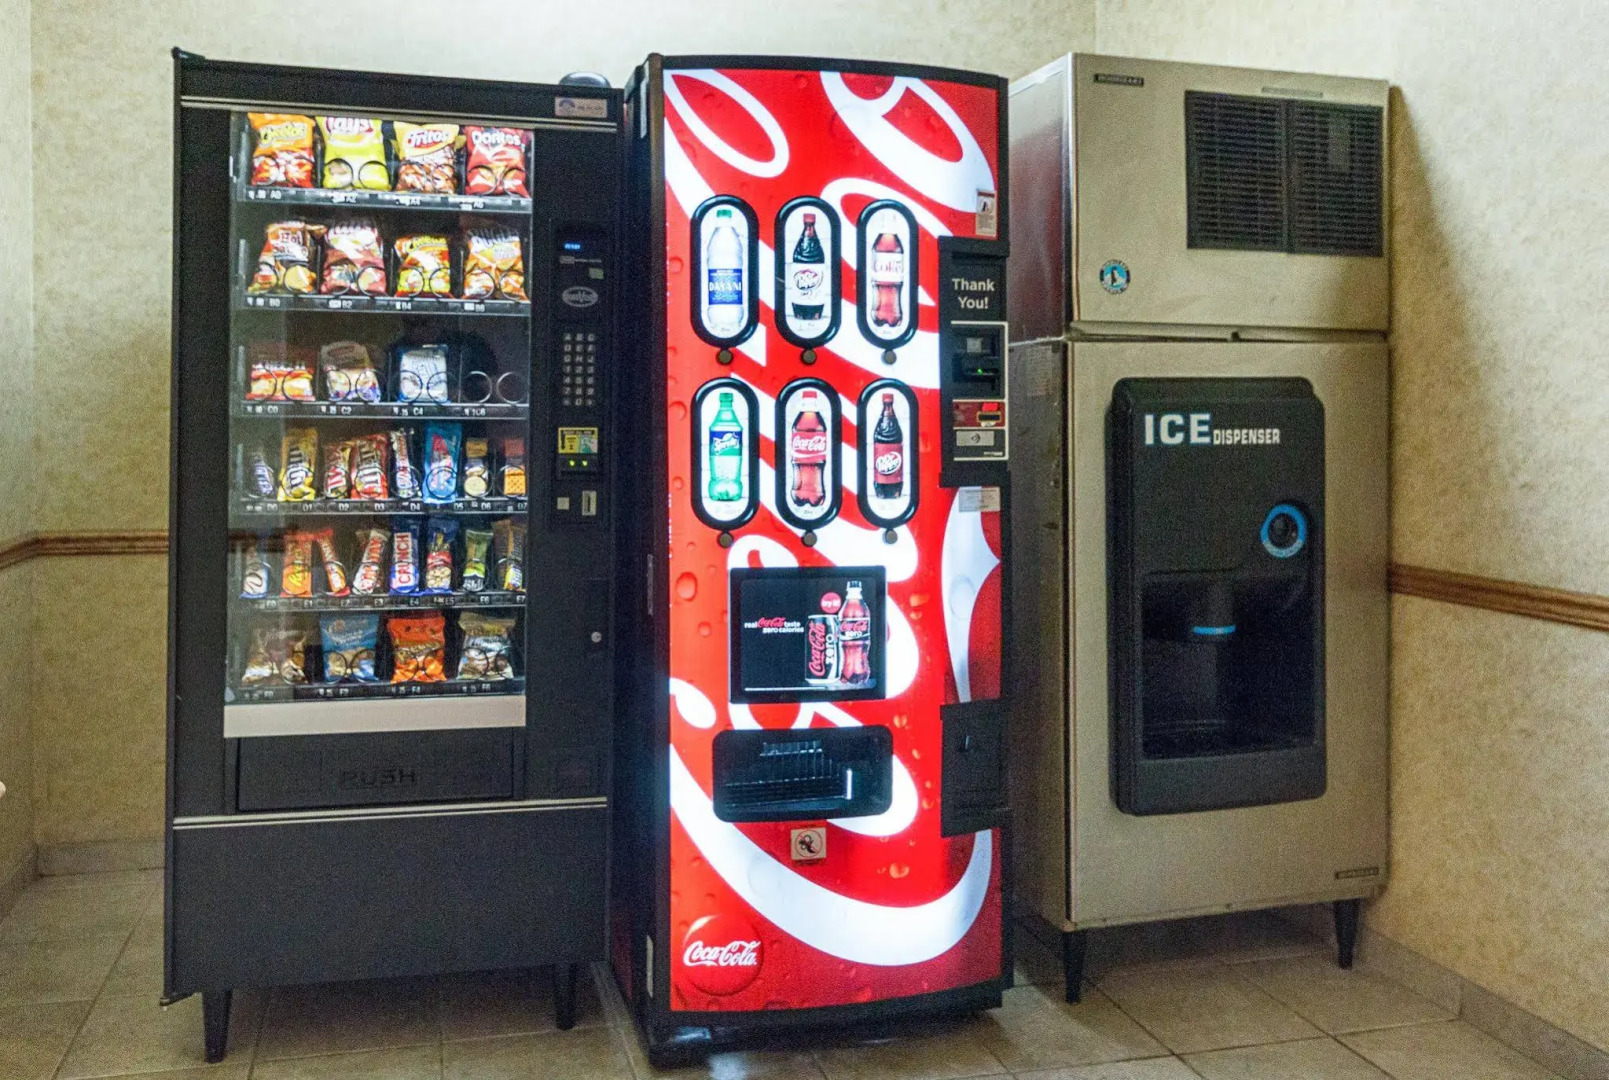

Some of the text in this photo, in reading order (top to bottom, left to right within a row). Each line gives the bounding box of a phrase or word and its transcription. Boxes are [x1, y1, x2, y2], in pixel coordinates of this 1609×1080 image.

[407, 130, 450, 148] Fritos
[471, 130, 522, 146] Doritos
[709, 282, 742, 292] DASANI
[952, 278, 995, 291] Thank
[958, 297, 988, 309] You!
[1145, 414, 1280, 445] ICE DISPENSER
[395, 532, 412, 584] CRUNCH
[808, 620, 826, 676] Coca-Cola
[826, 634, 836, 664] zero
[341, 768, 416, 786] PUSH
[683, 940, 761, 967] Coca-Cola
